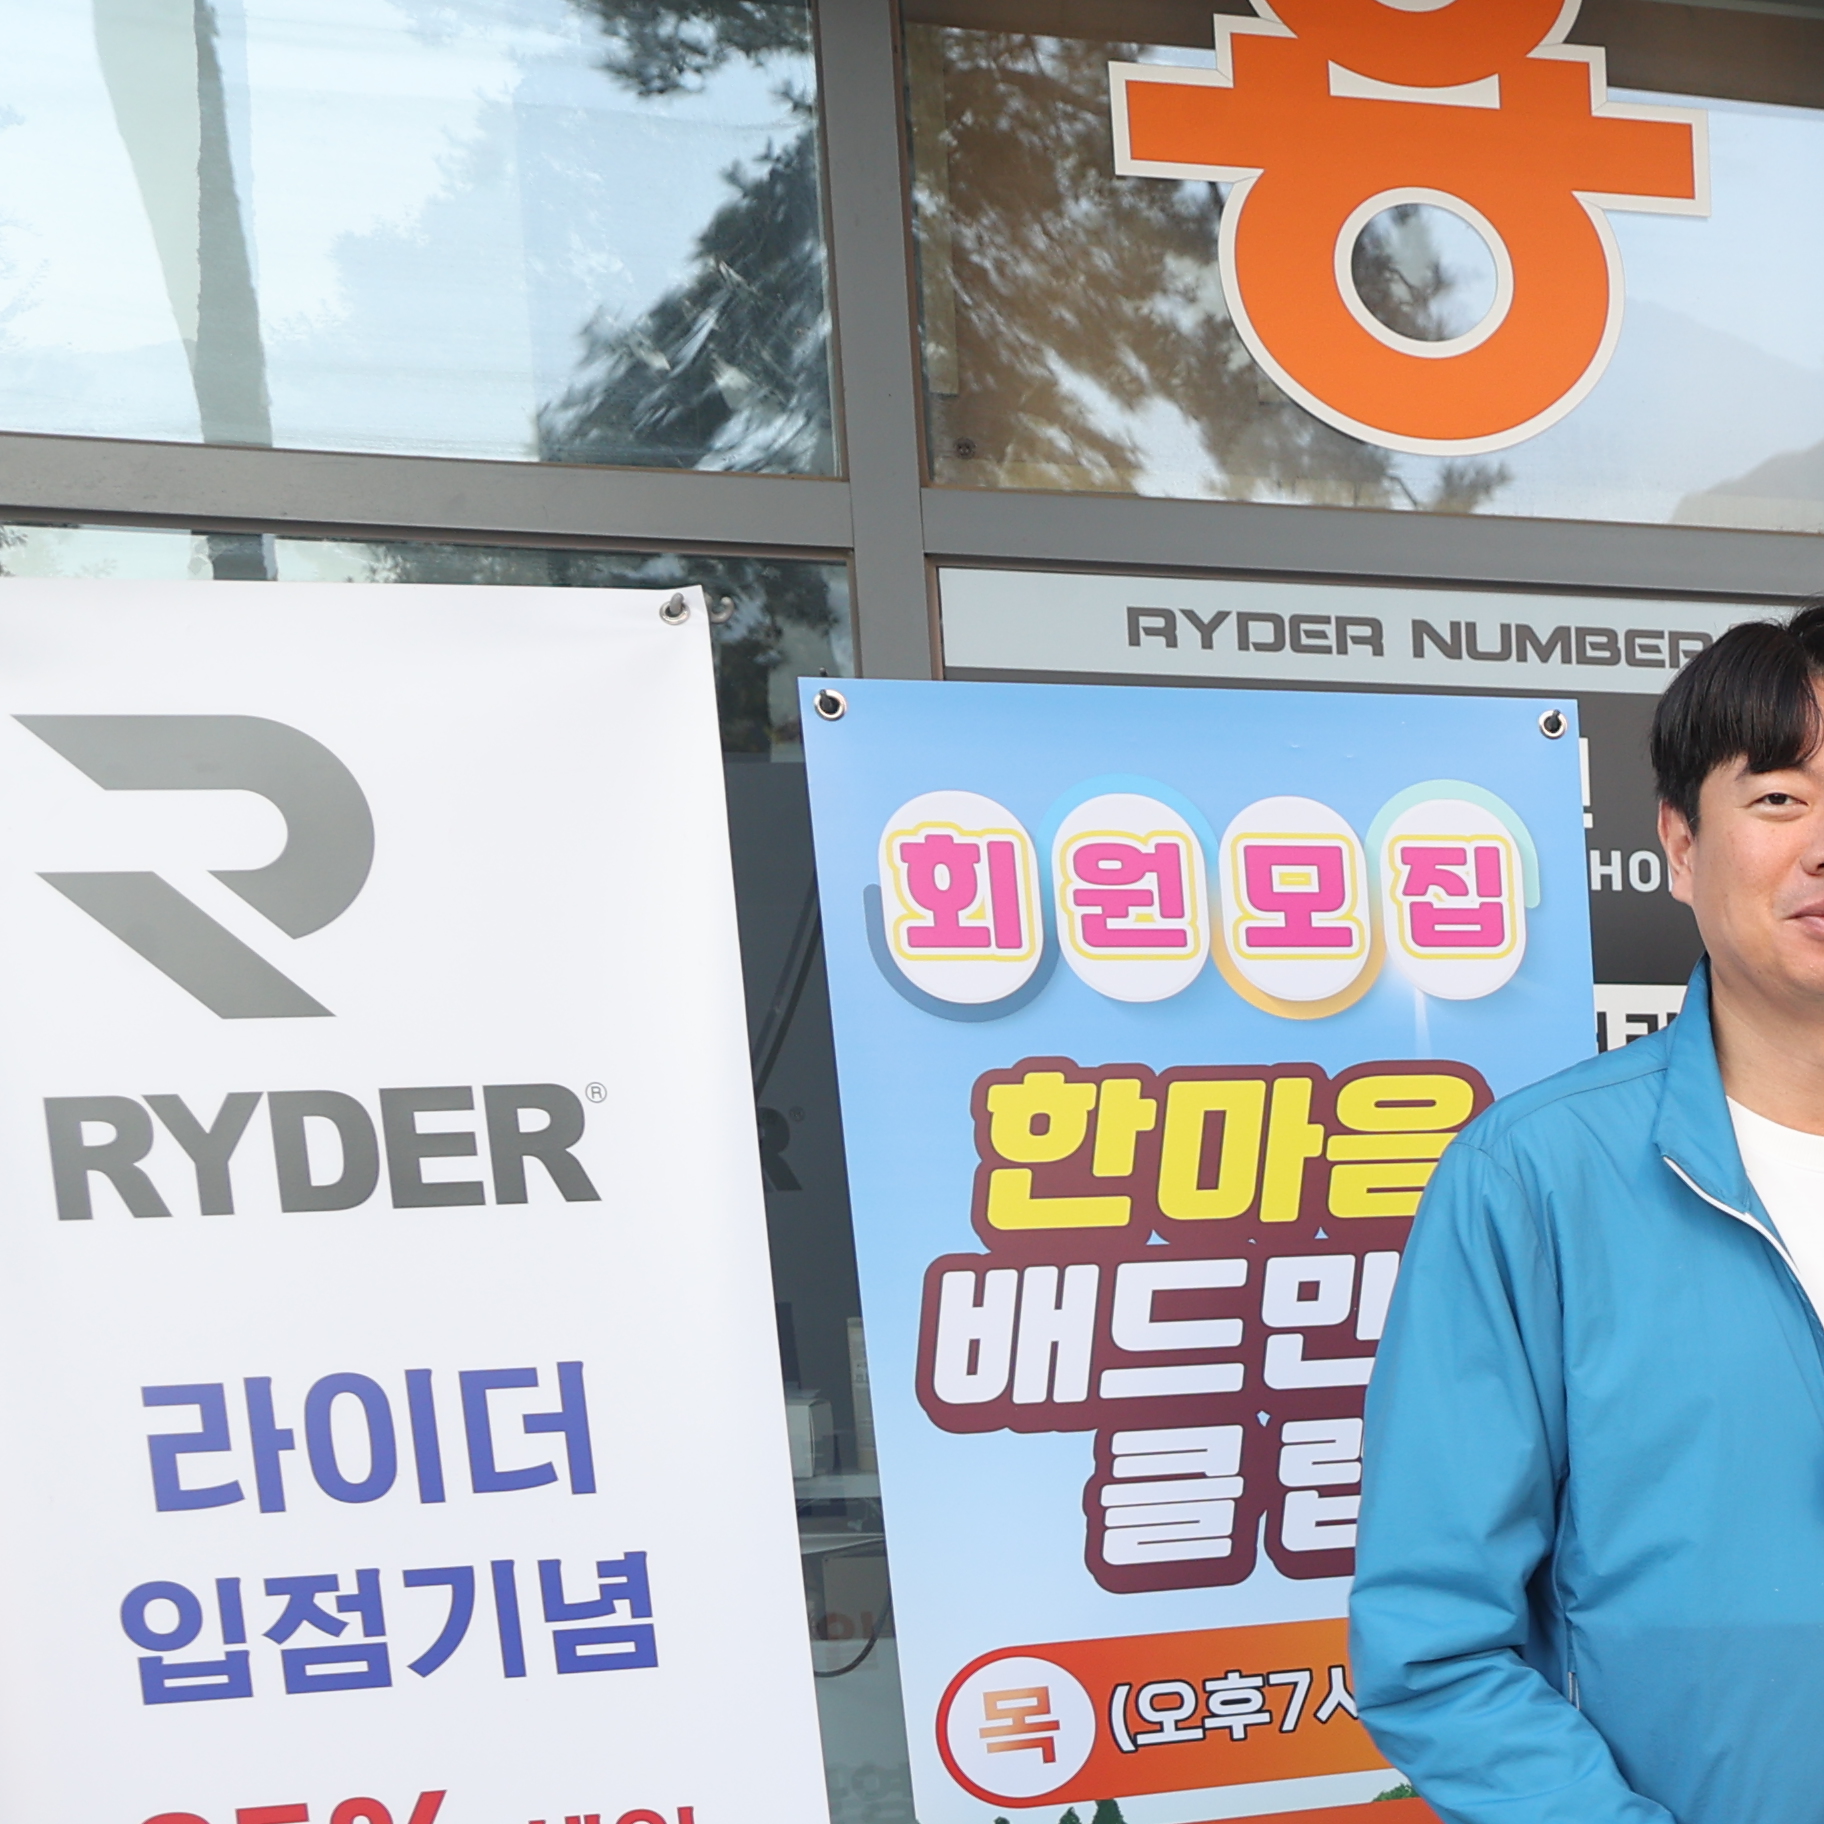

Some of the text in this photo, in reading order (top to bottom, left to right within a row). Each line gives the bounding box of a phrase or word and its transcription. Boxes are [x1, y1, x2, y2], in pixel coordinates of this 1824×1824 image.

[1125, 605, 1385, 657] RYDER
[985, 1070, 1475, 1232] 한마음
[140, 1359, 598, 1515] 라이더
[119, 1550, 659, 1707] 입점기념
[977, 1684, 1062, 1766] 목
